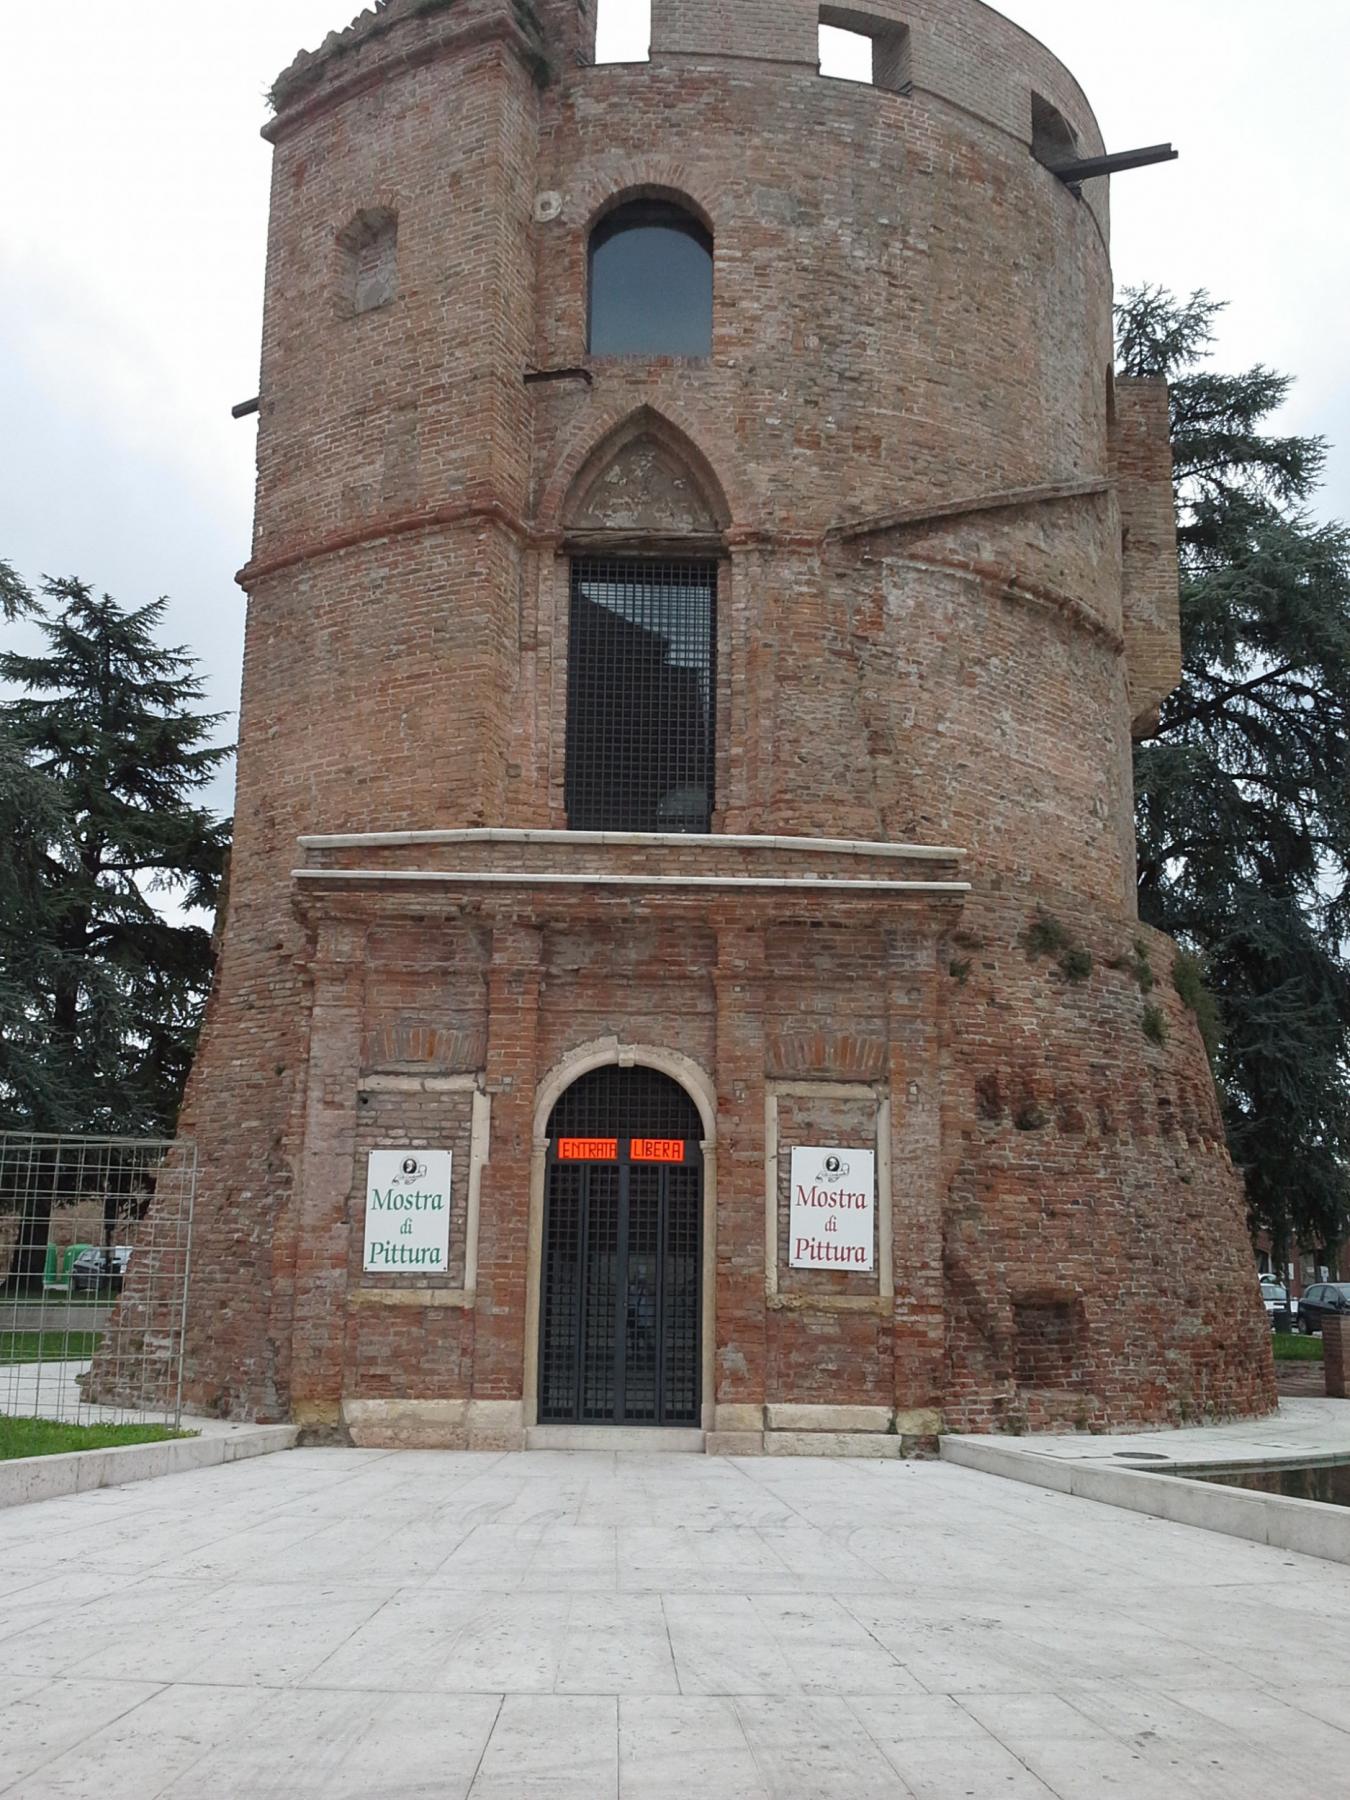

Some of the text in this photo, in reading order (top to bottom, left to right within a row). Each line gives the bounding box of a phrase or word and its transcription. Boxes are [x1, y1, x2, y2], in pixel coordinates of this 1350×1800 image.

[633, 1140, 681, 1158] LIBERA
[370, 1188, 445, 1211] Mostra
[795, 1184, 868, 1209] Mostra
[400, 1217, 413, 1235] di
[824, 1215, 838, 1232] di
[368, 1240, 443, 1264] Pittura
[794, 1237, 868, 1263] Pittura
